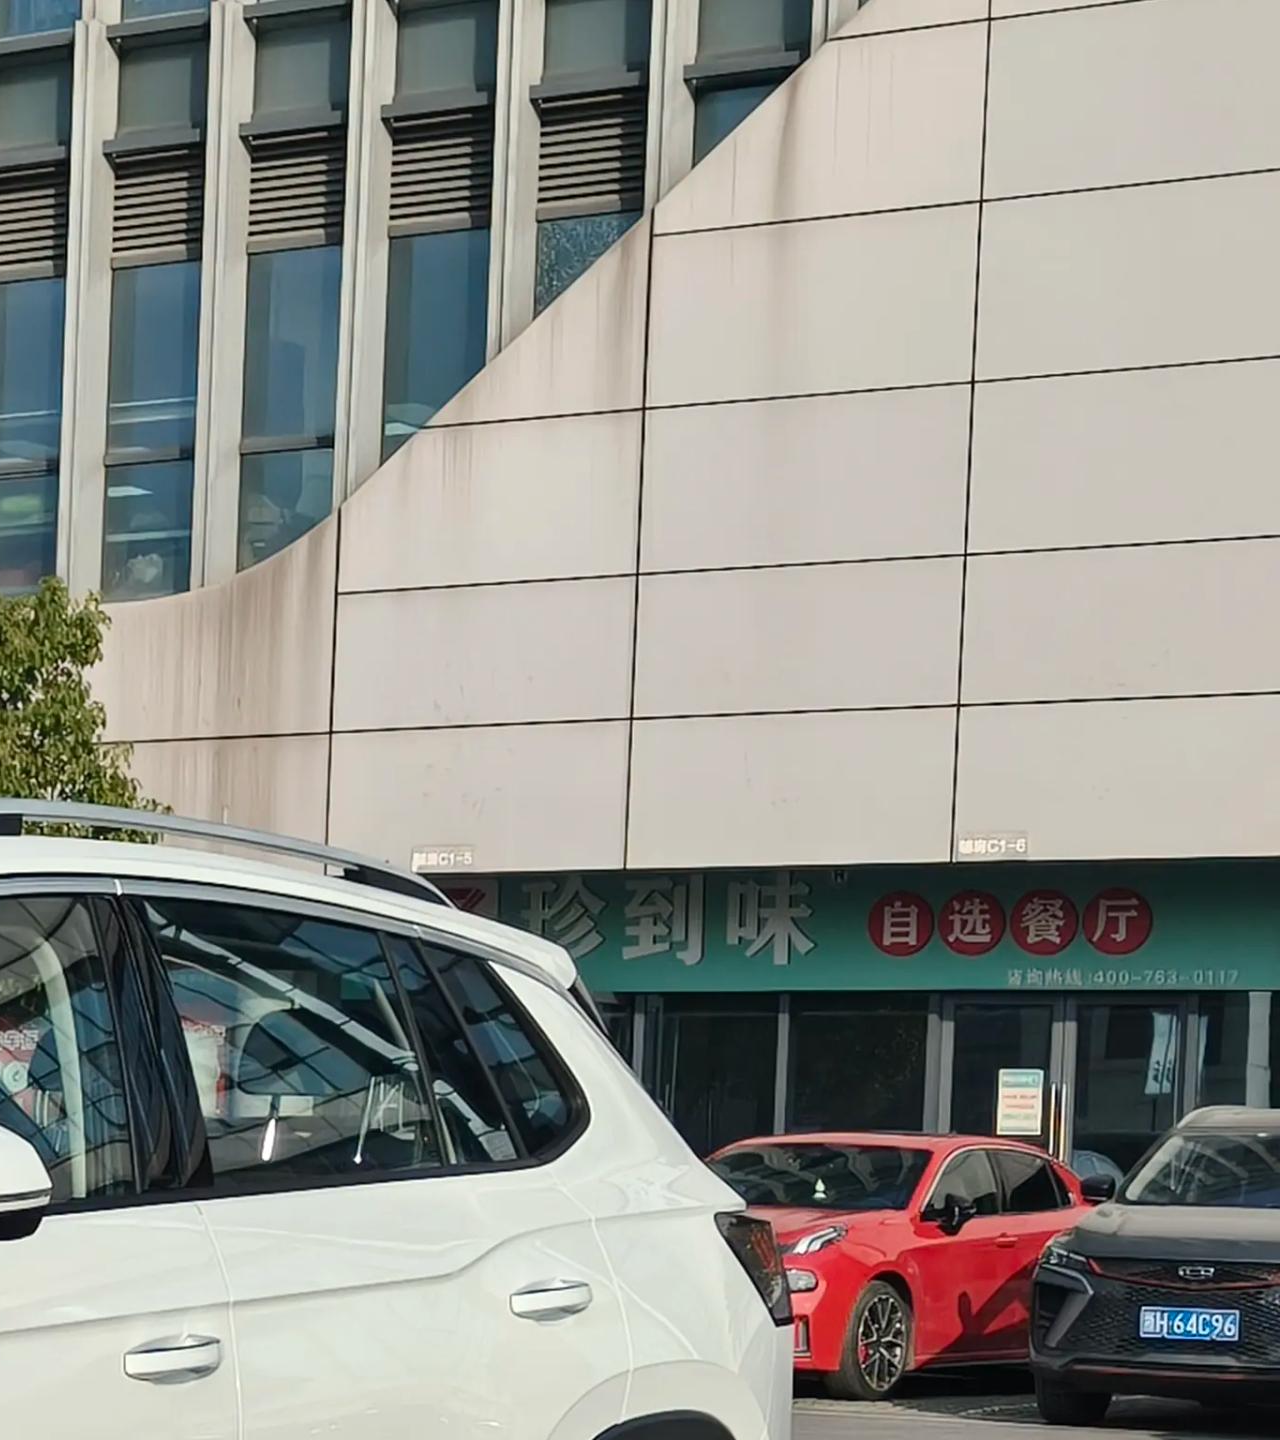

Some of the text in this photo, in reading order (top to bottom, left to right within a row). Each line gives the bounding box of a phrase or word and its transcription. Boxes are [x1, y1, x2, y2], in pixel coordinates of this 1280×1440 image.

[521, 873, 815, 966] 珍到味
[880, 895, 1139, 948] 自选餐厅
